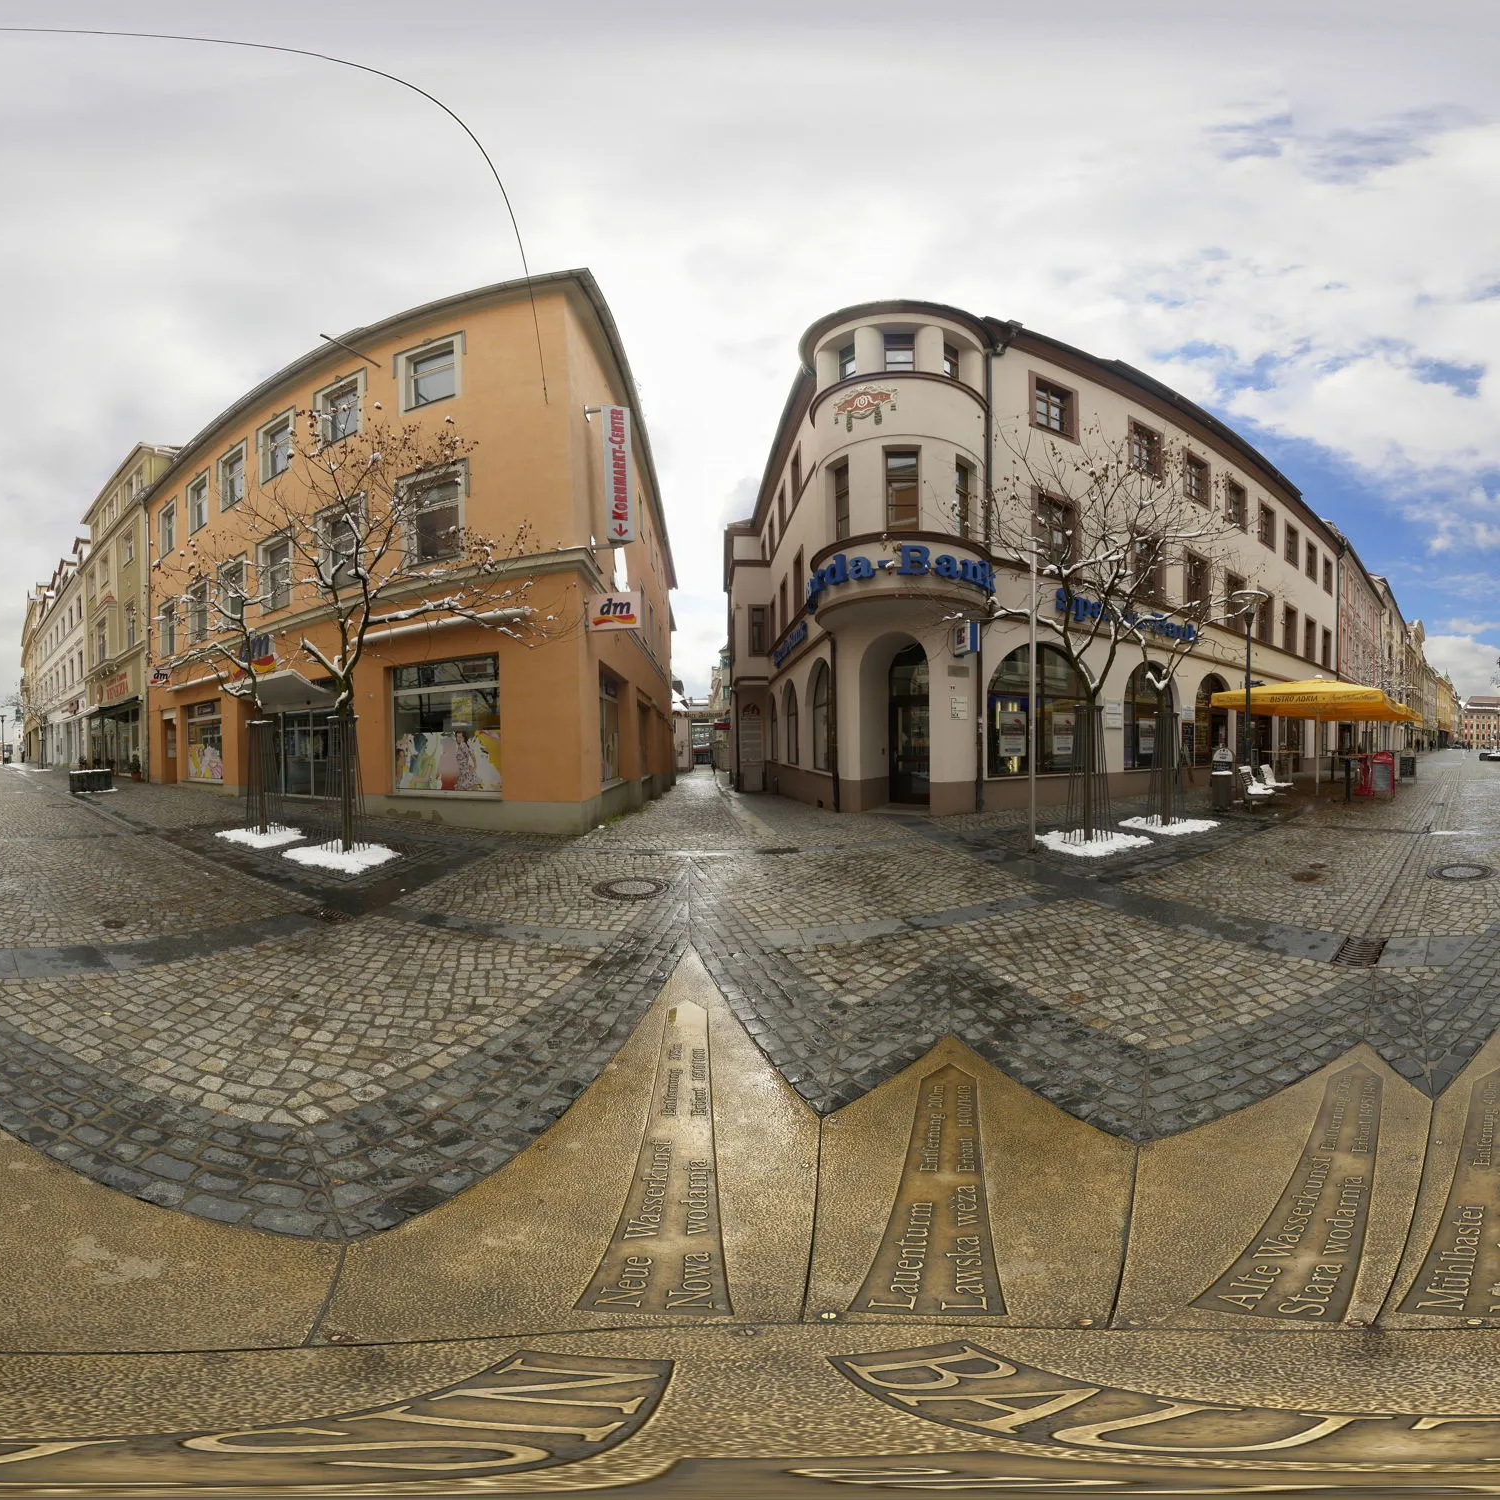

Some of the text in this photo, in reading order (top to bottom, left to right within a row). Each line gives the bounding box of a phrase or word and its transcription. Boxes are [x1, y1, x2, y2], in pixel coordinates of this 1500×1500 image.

[600, 598, 631, 617] dm
[153, 669, 169, 681] dm
[1269, 695, 1319, 703] BISTRO ADRIA
[691, 1089, 708, 1118] Erbaut
[919, 1085, 946, 1173] Entfernung 200m
[1320, 1094, 1350, 1151] Entfernung
[956, 1138, 975, 1173] Erbaut
[1350, 1122, 1370, 1154] Erbaut
[1473, 1107, 1499, 1167] Entfernung
[594, 1139, 673, 1309] Neue Wasserkunst
[665, 1158, 716, 1310] Nowa wodarnja
[1217, 1154, 1332, 1311] Alte Wasserkunst
[1277, 1175, 1369, 1317] Stara wodarnja
[867, 1201, 933, 1311] Lauenturm
[1415, 1204, 1486, 1311] Mühlbastei
